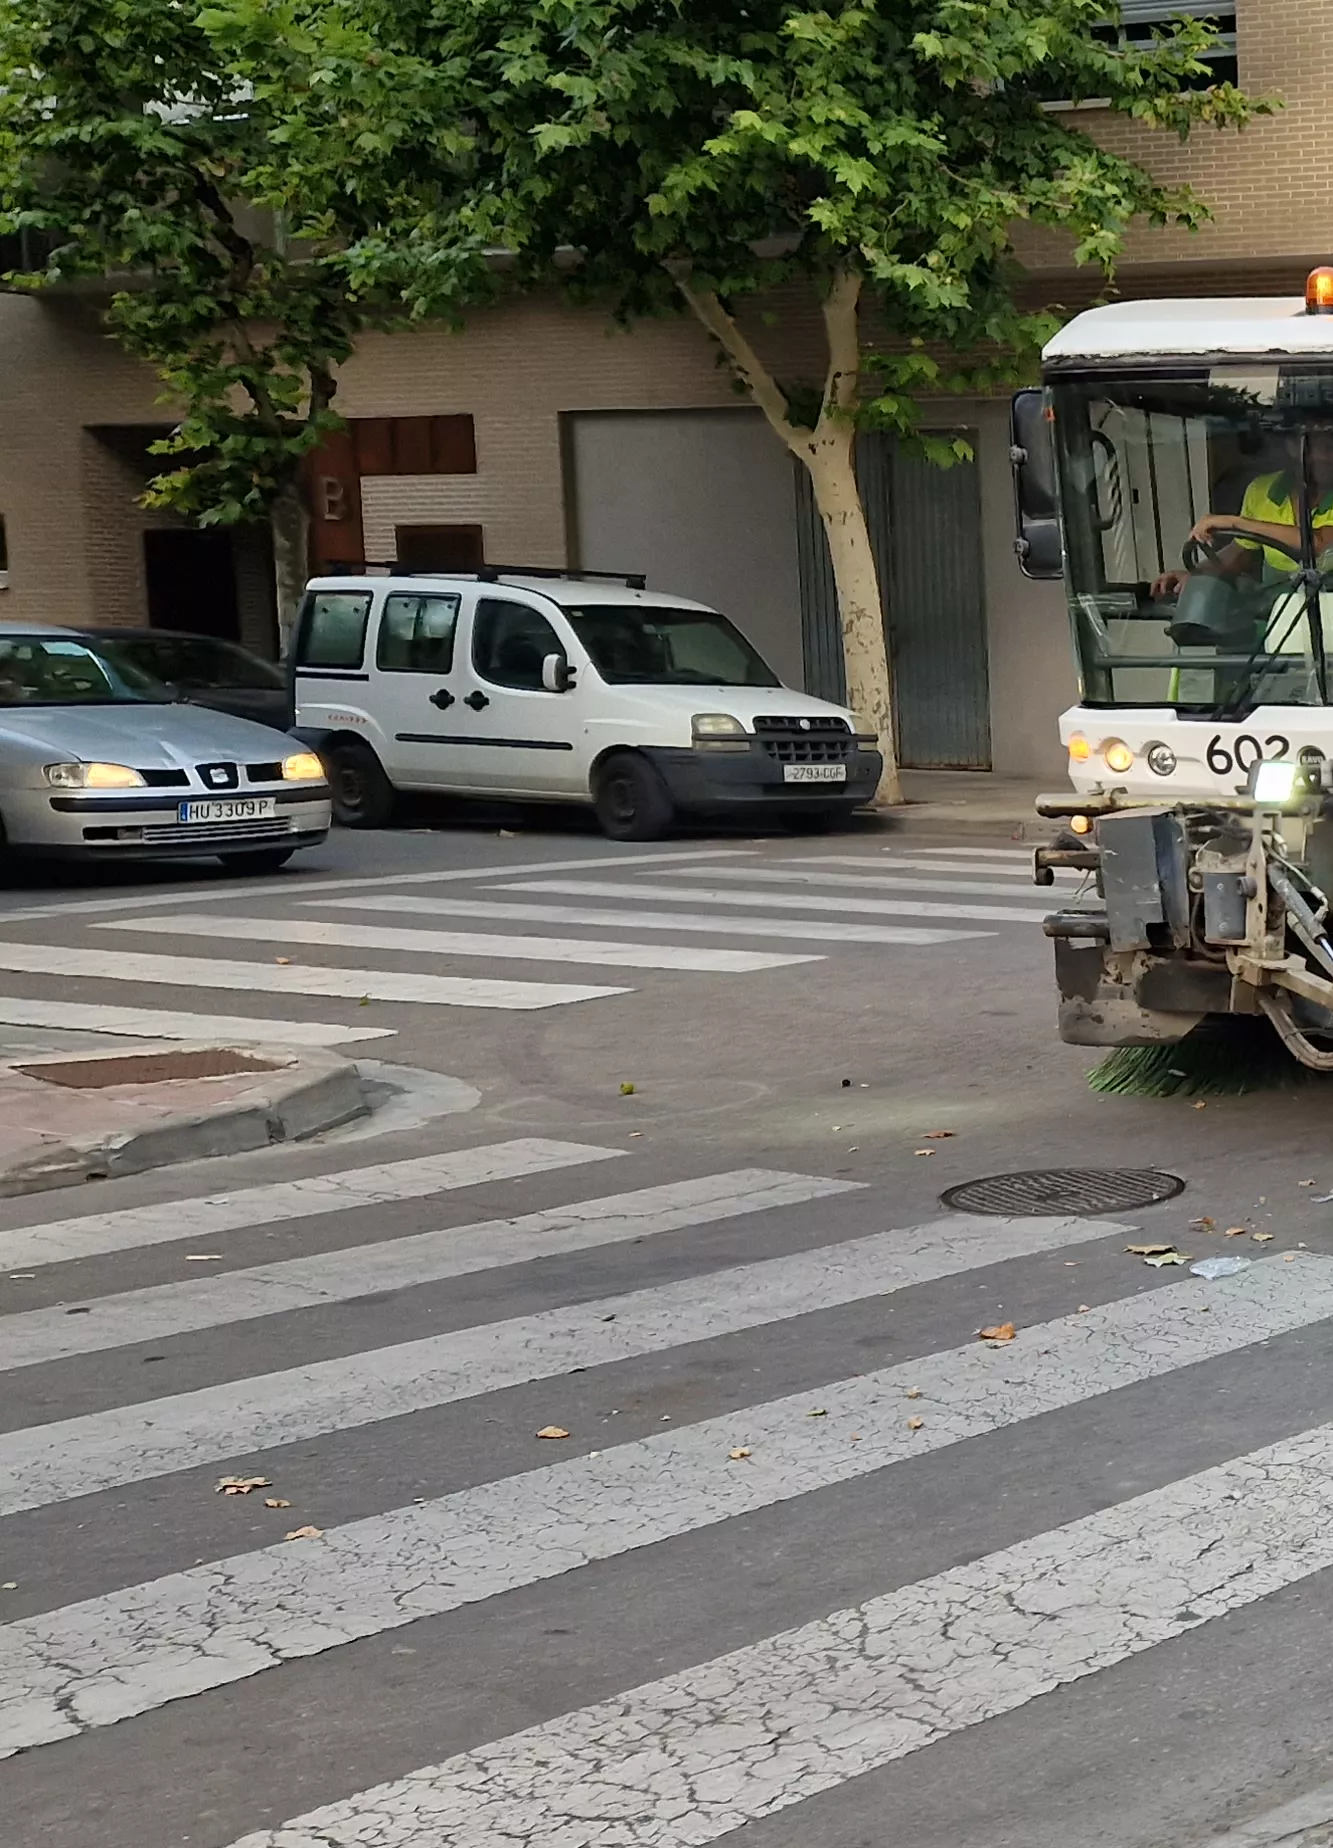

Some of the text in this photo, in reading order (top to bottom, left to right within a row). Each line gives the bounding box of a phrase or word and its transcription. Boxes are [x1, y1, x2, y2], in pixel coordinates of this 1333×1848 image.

[1206, 734, 1289, 774] 602
[793, 767, 820, 779] 2793
[190, 800, 268, 819] HU 3309 P
